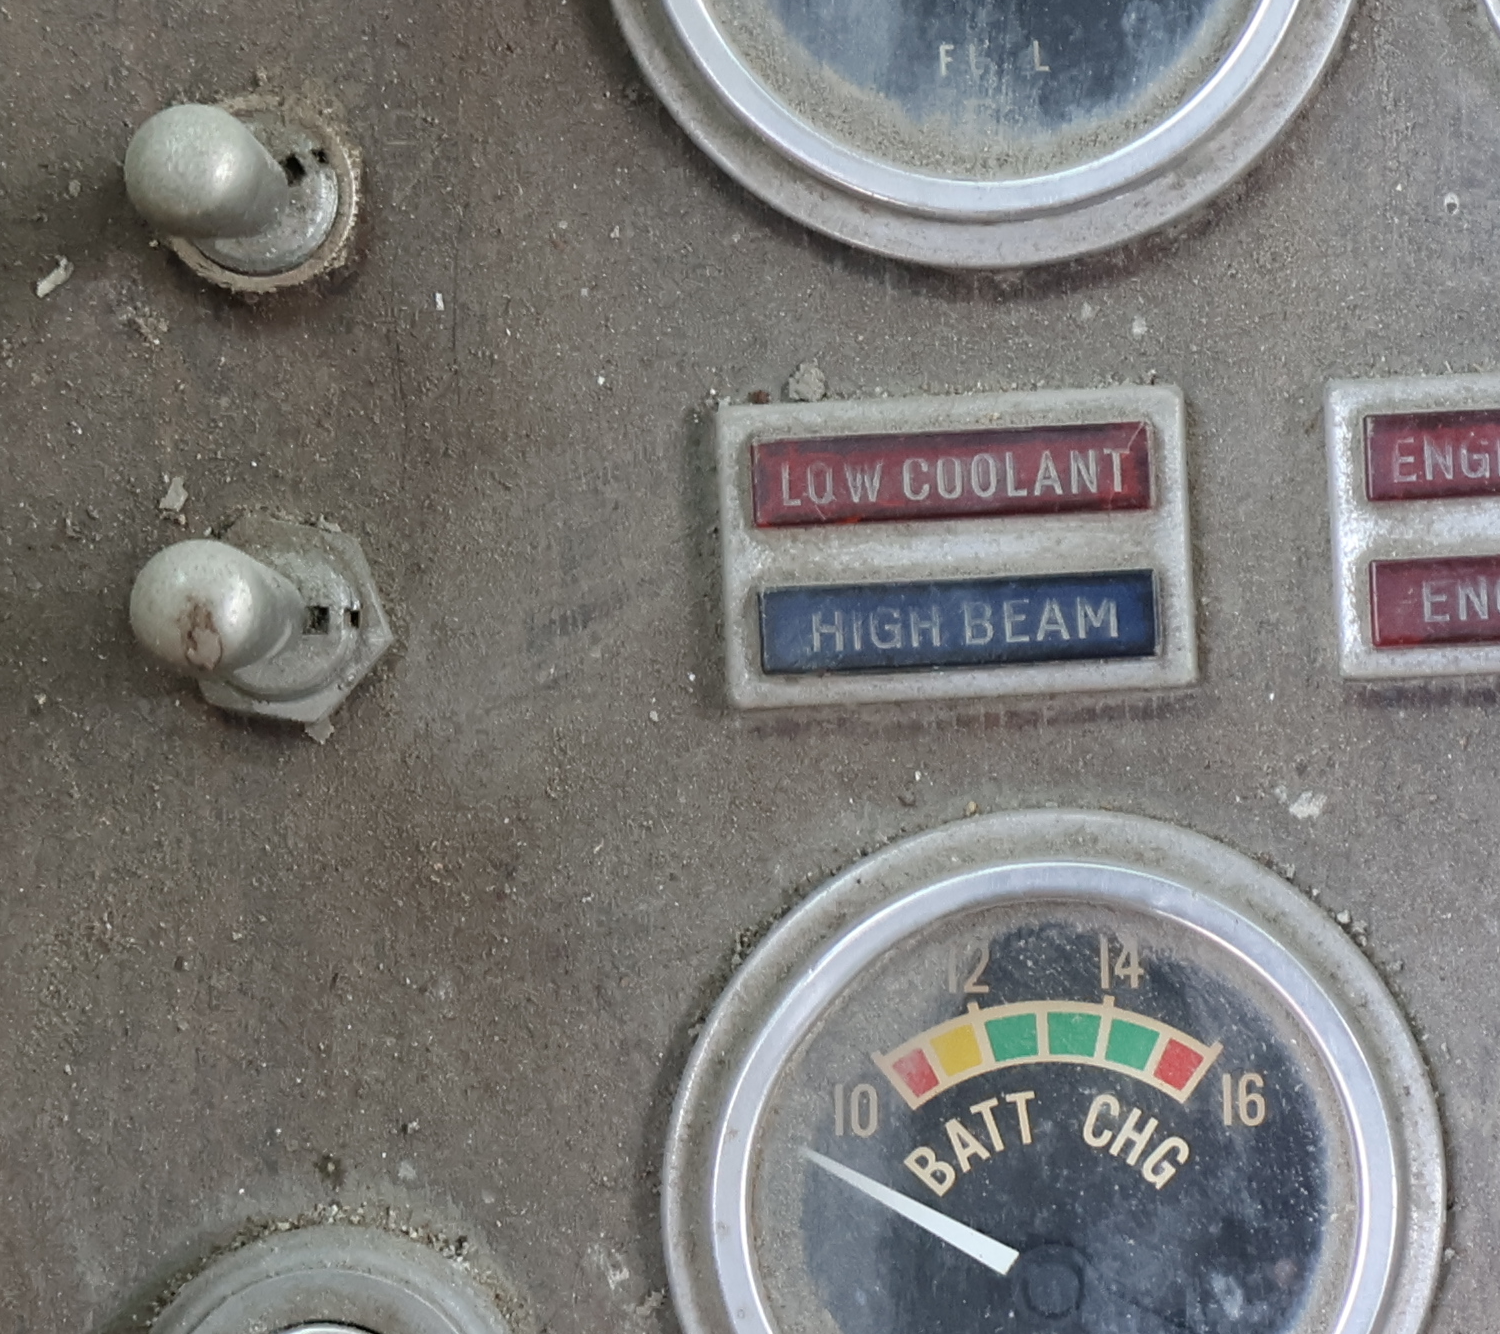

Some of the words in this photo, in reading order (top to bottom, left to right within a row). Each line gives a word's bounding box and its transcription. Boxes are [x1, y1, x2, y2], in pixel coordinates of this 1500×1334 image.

[938, 39, 1050, 77] FUL
[780, 459, 884, 507] LOW
[902, 447, 1132, 502] COOLANT
[810, 604, 941, 654] HIGH
[963, 595, 1120, 647] BEAM
[948, 943, 990, 994] 12
[1099, 936, 1145, 990] 14
[833, 1082, 880, 1138] 10
[1222, 1072, 1267, 1127] 16
[902, 1089, 1040, 1198] BATT
[1080, 1092, 1191, 1190] CHG
